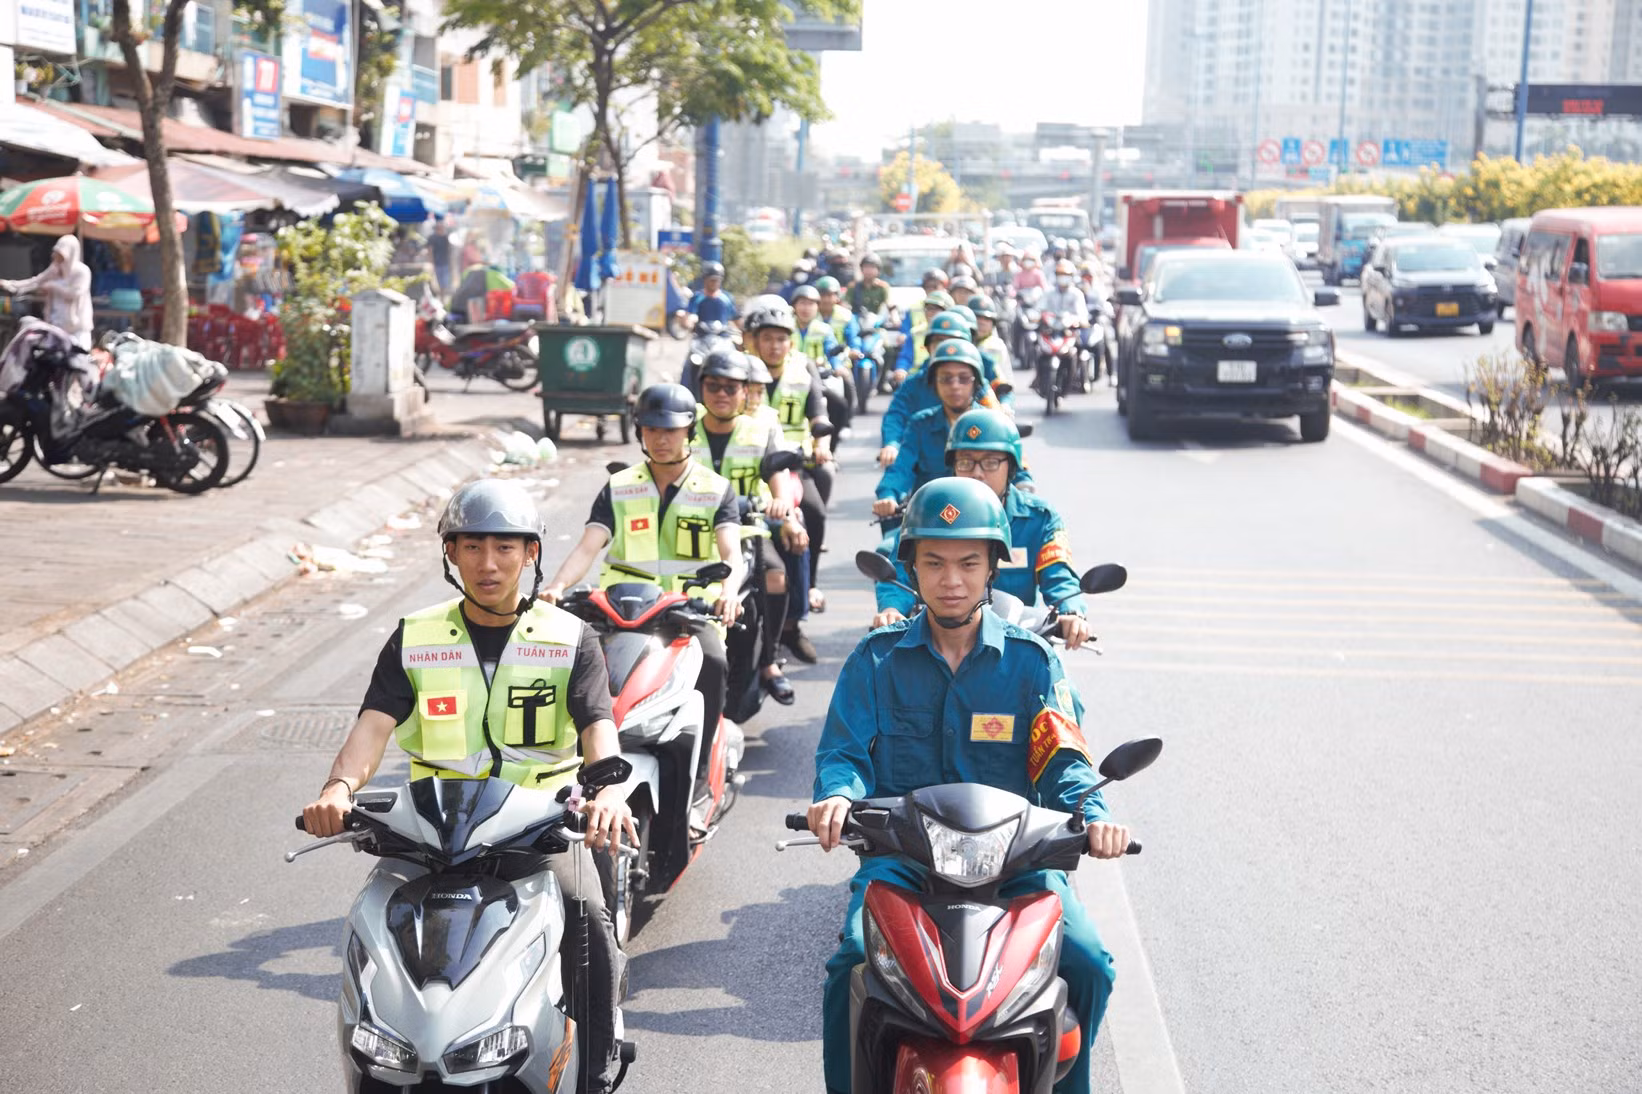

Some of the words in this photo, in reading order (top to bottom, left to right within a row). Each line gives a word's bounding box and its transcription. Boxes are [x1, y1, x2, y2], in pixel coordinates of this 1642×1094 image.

[409, 651, 438, 663] NHÂN
[441, 649, 462, 661] DÂN
[549, 649, 569, 658] TRA
